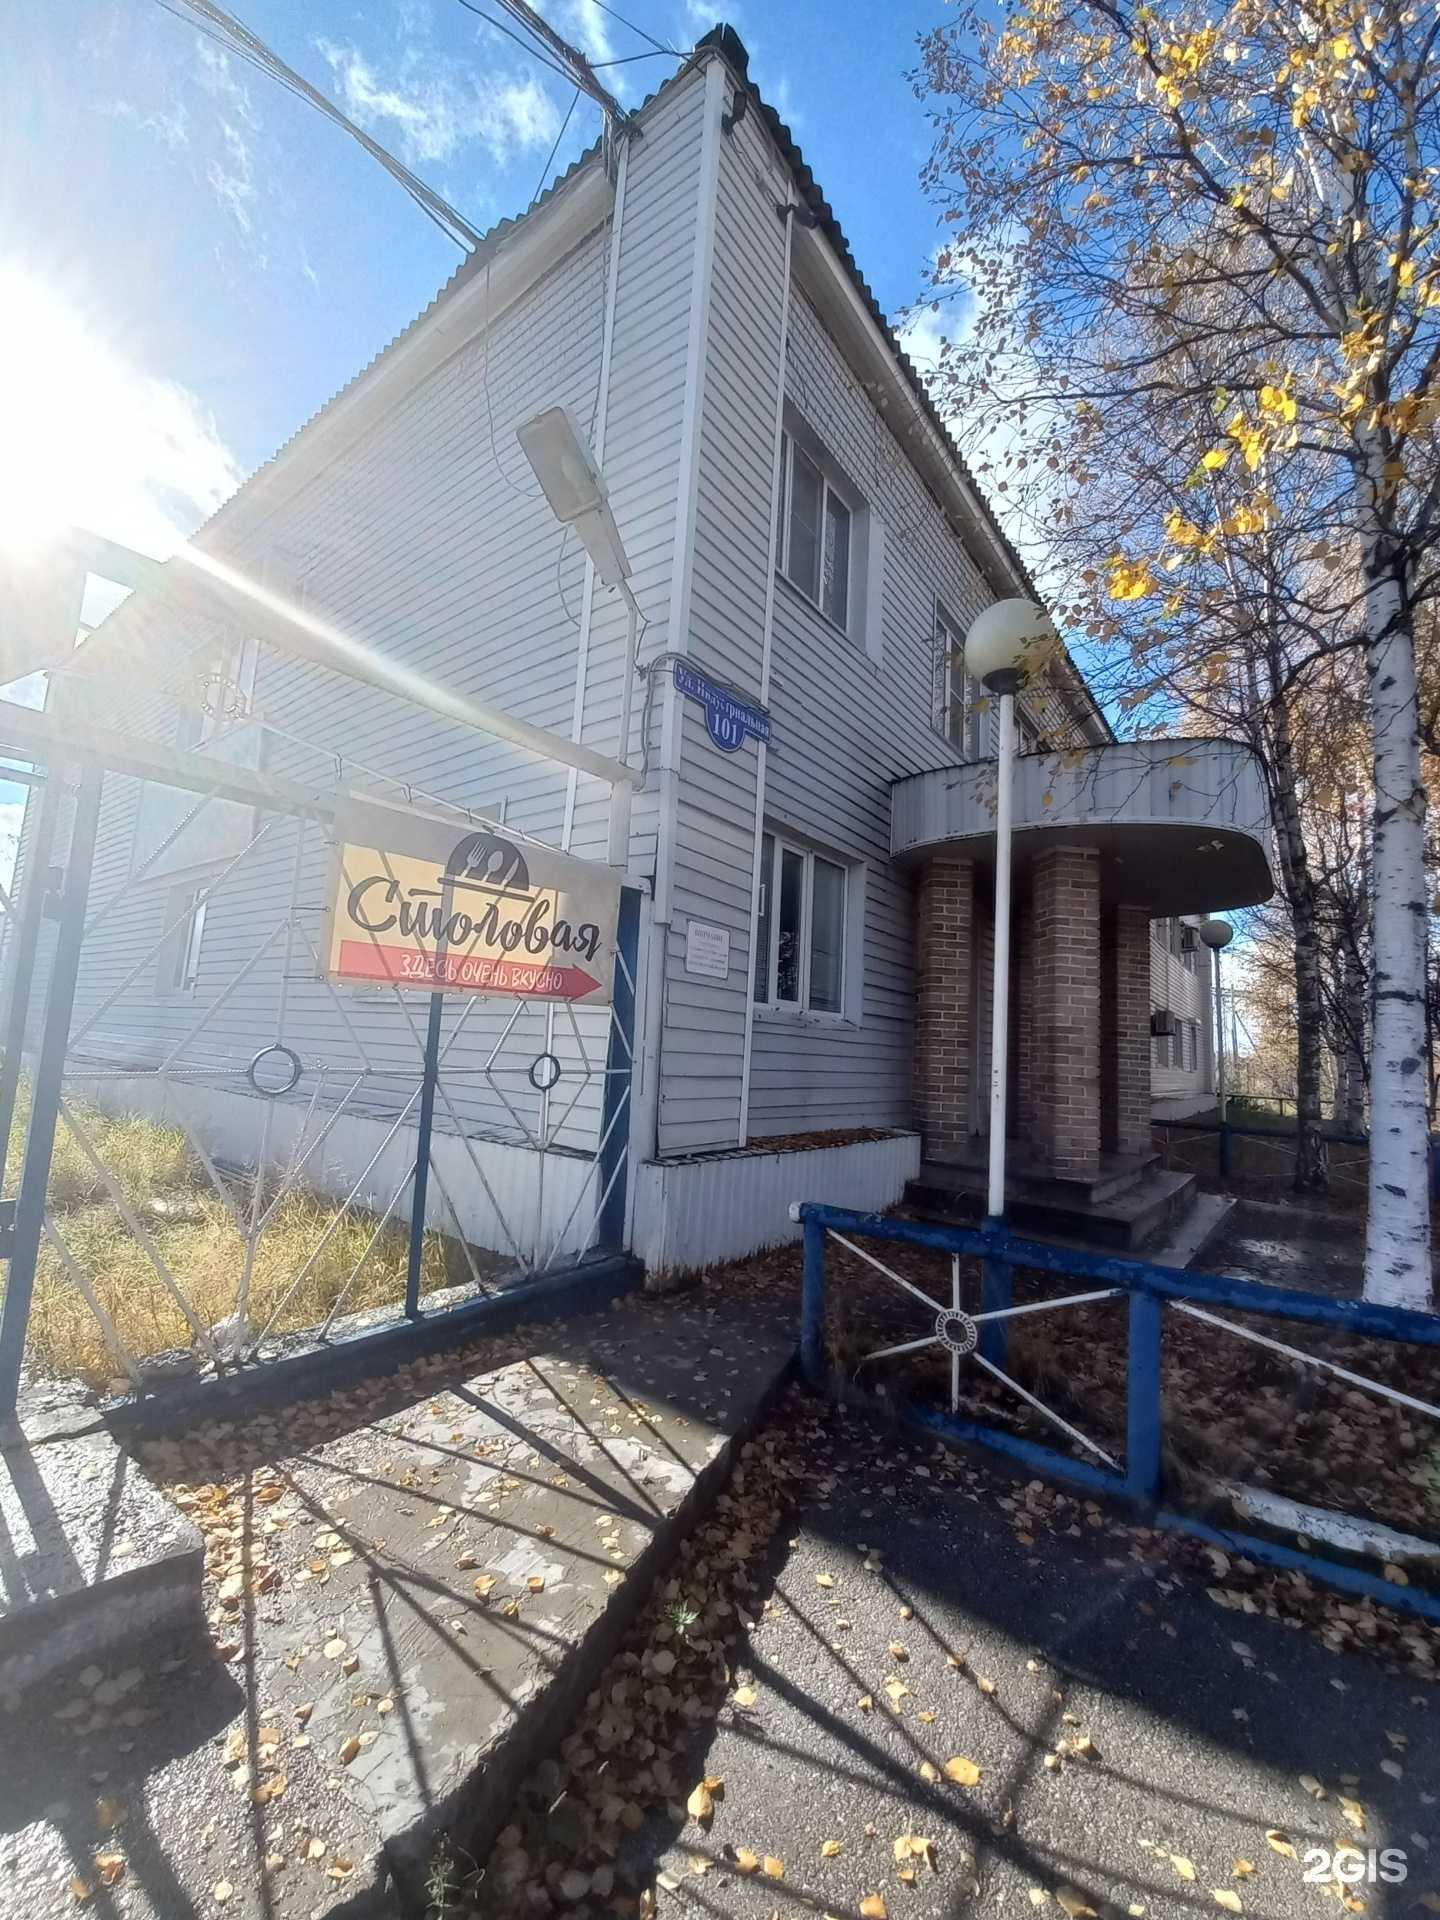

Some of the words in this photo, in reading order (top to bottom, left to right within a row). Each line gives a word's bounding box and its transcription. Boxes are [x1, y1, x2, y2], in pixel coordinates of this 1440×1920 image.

[713, 714, 737, 745] 101
[347, 876, 602, 962] Столовая
[400, 954, 457, 981] ЗДЕСЬ
[462, 959, 508, 986] ОЧЕНЬ
[511, 967, 562, 990] ВКУСНО
